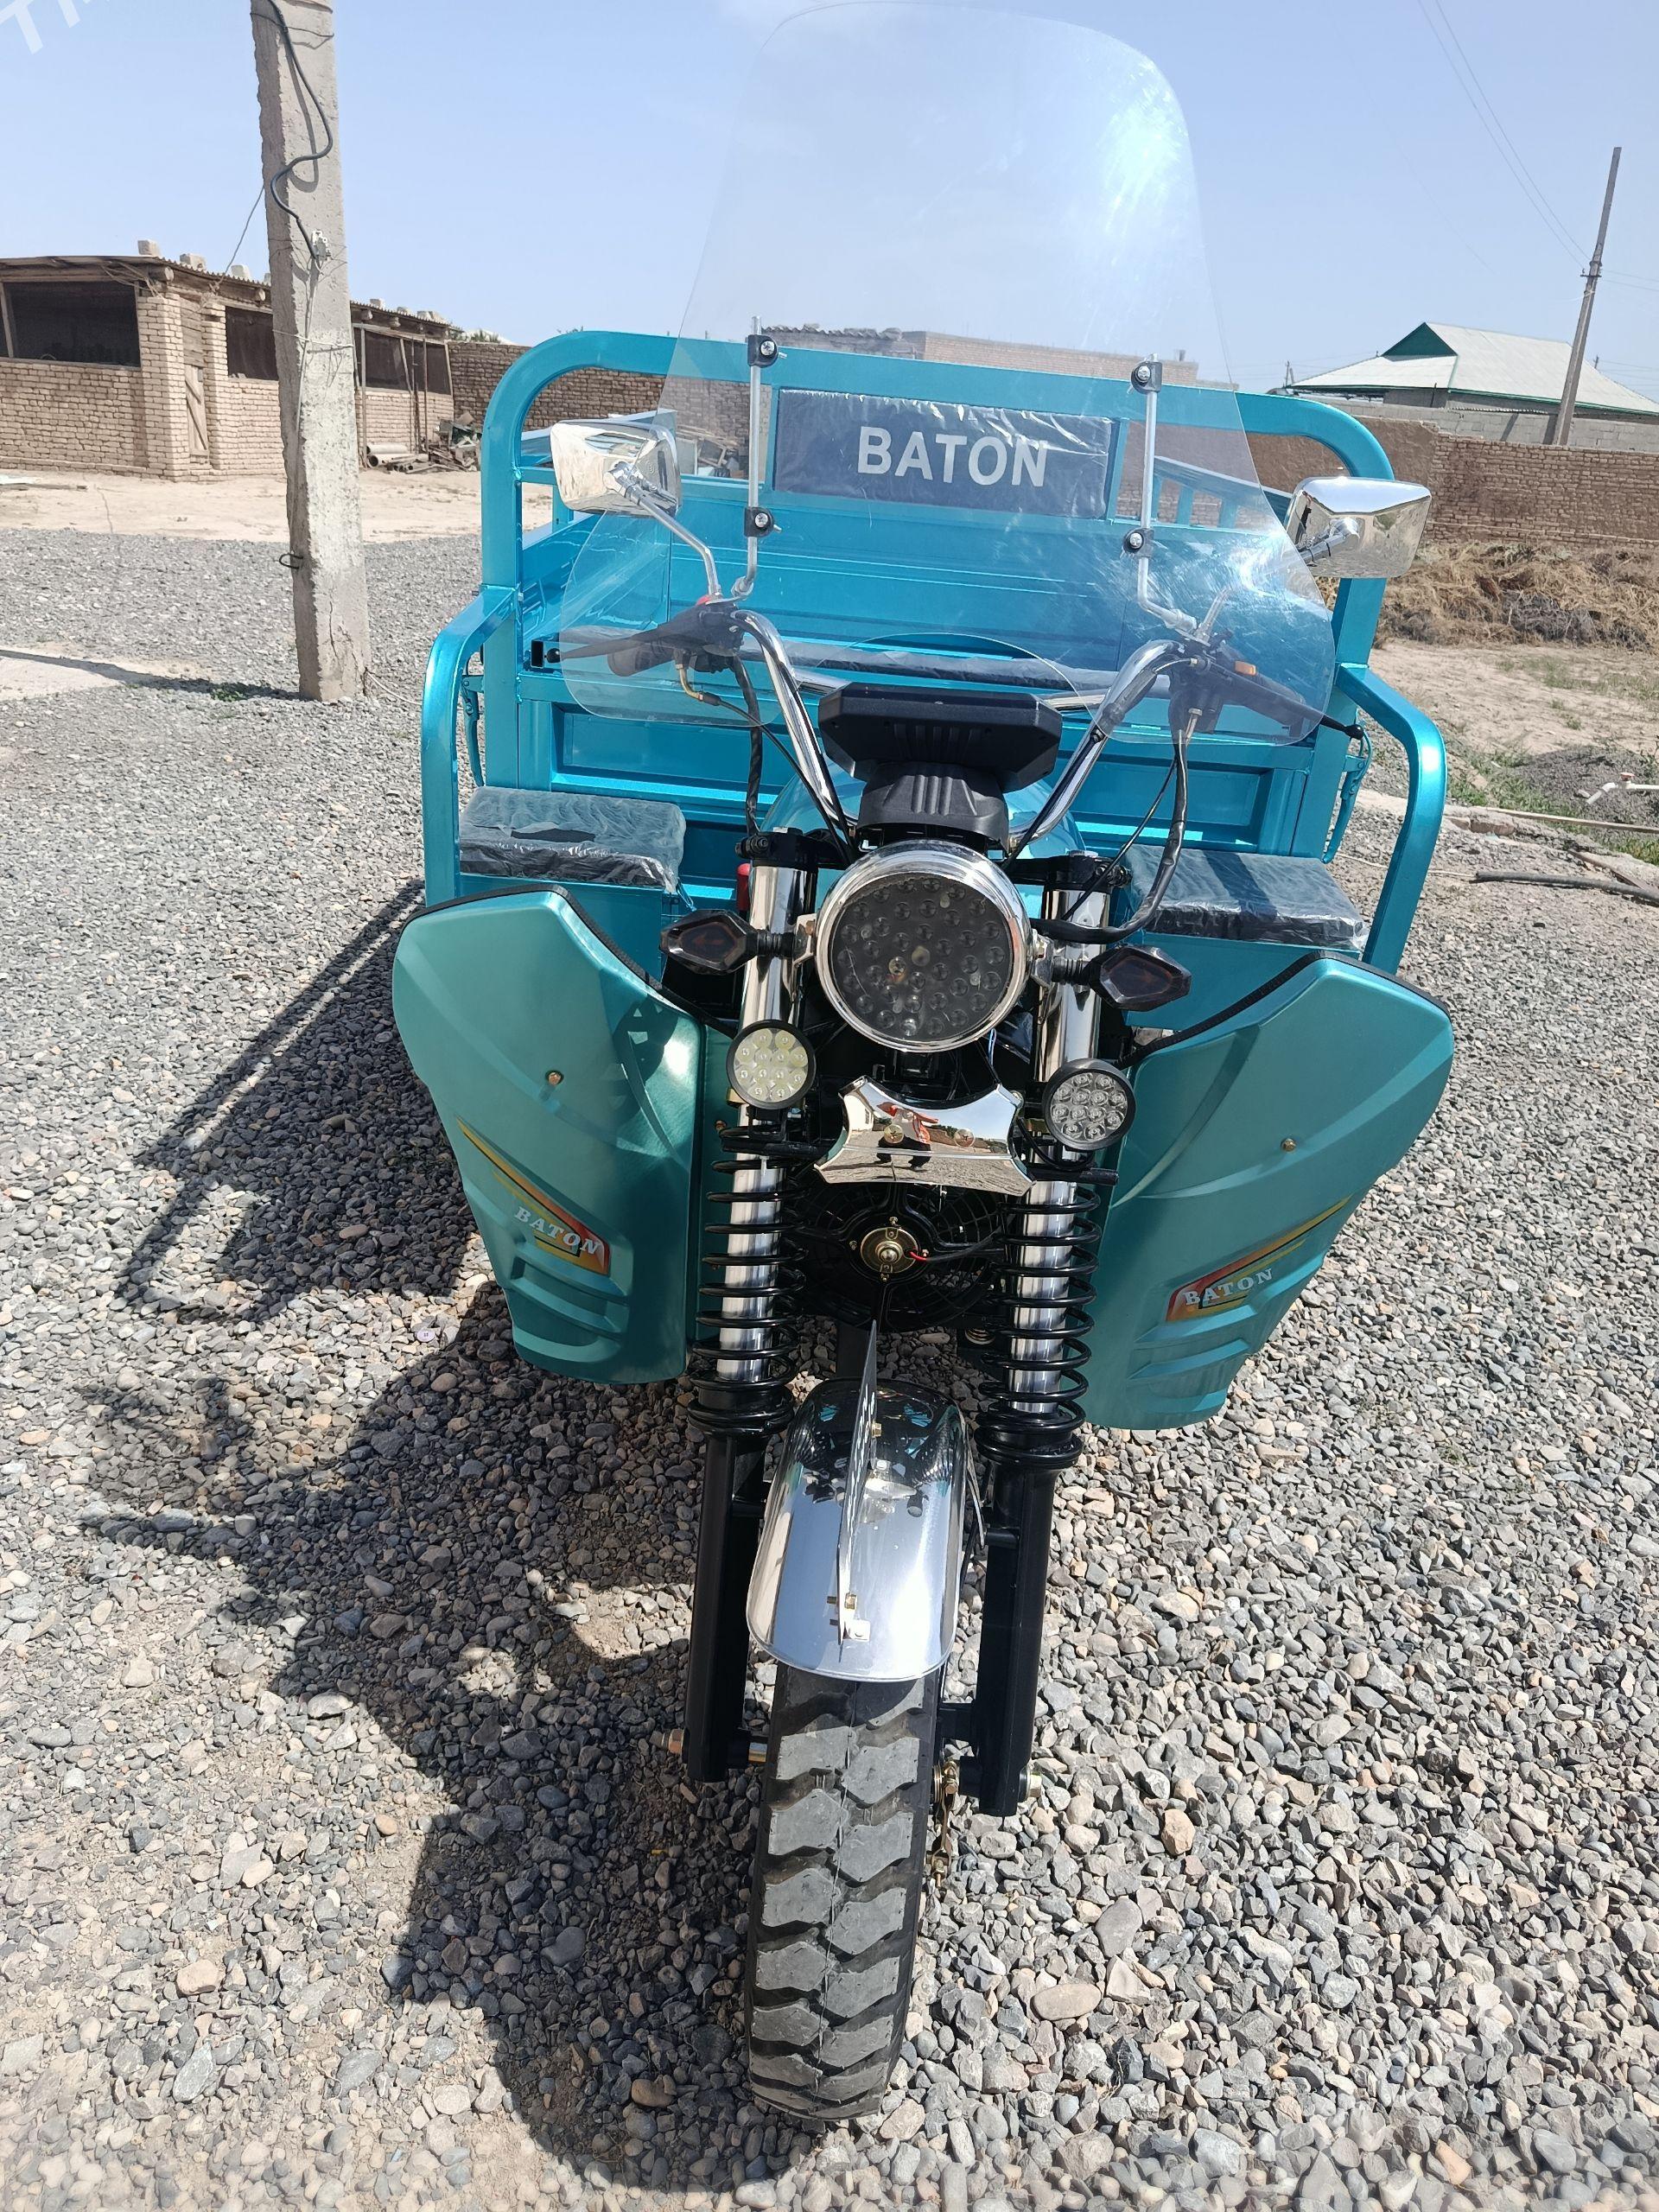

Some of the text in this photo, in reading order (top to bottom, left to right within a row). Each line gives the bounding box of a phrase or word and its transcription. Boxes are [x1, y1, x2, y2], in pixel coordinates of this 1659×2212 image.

[857, 426, 1046, 487] BATON
[514, 1206, 601, 1255] BATON
[1183, 1268, 1273, 1306] BATON
